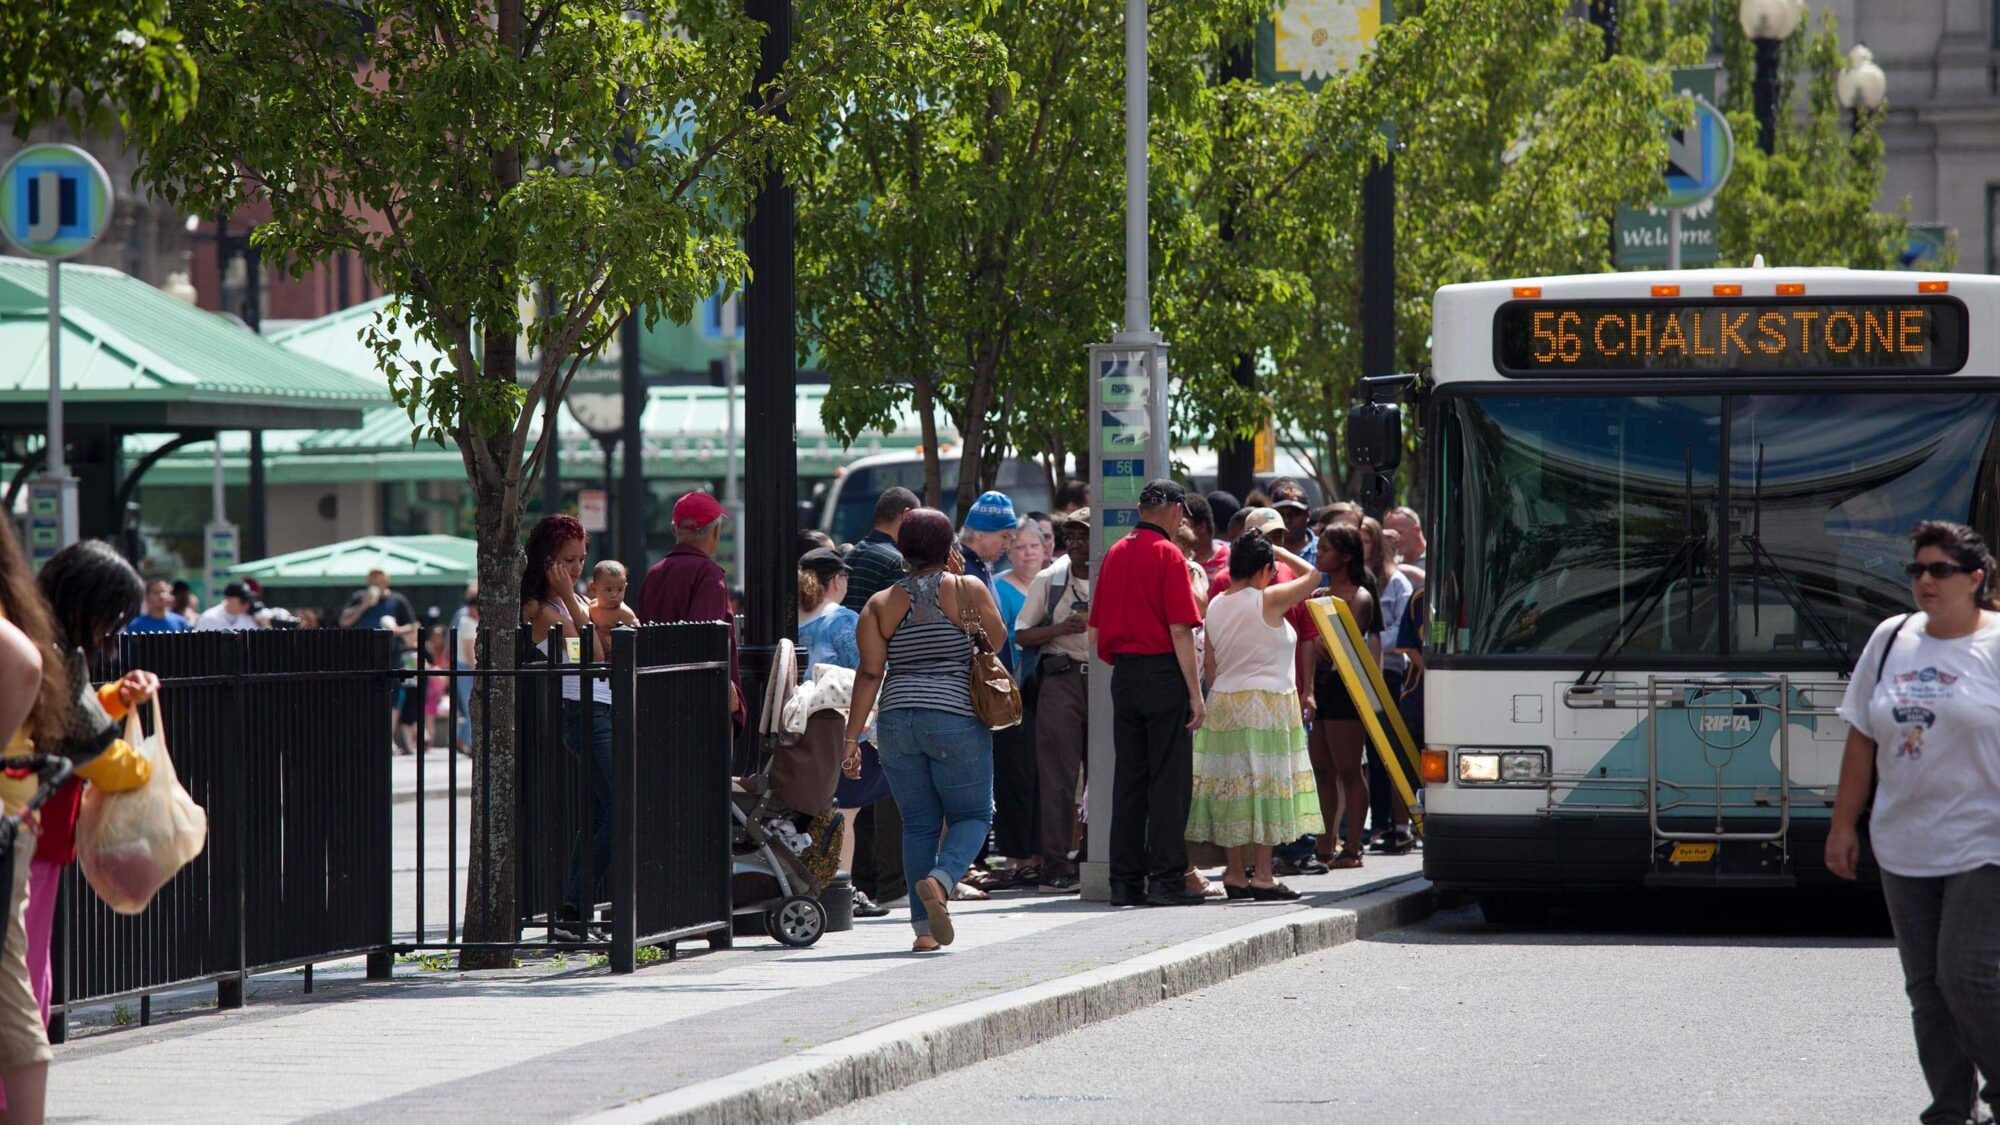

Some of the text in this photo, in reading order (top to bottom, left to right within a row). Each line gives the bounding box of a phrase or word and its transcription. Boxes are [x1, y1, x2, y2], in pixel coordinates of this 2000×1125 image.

[1623, 226, 1712, 247] Welcme
[1533, 309, 1924, 362] 56 CHALKSTONE
[1116, 461, 1131, 474] 56
[1117, 511, 1132, 524] 57
[1699, 715, 1751, 732] RIPTA
